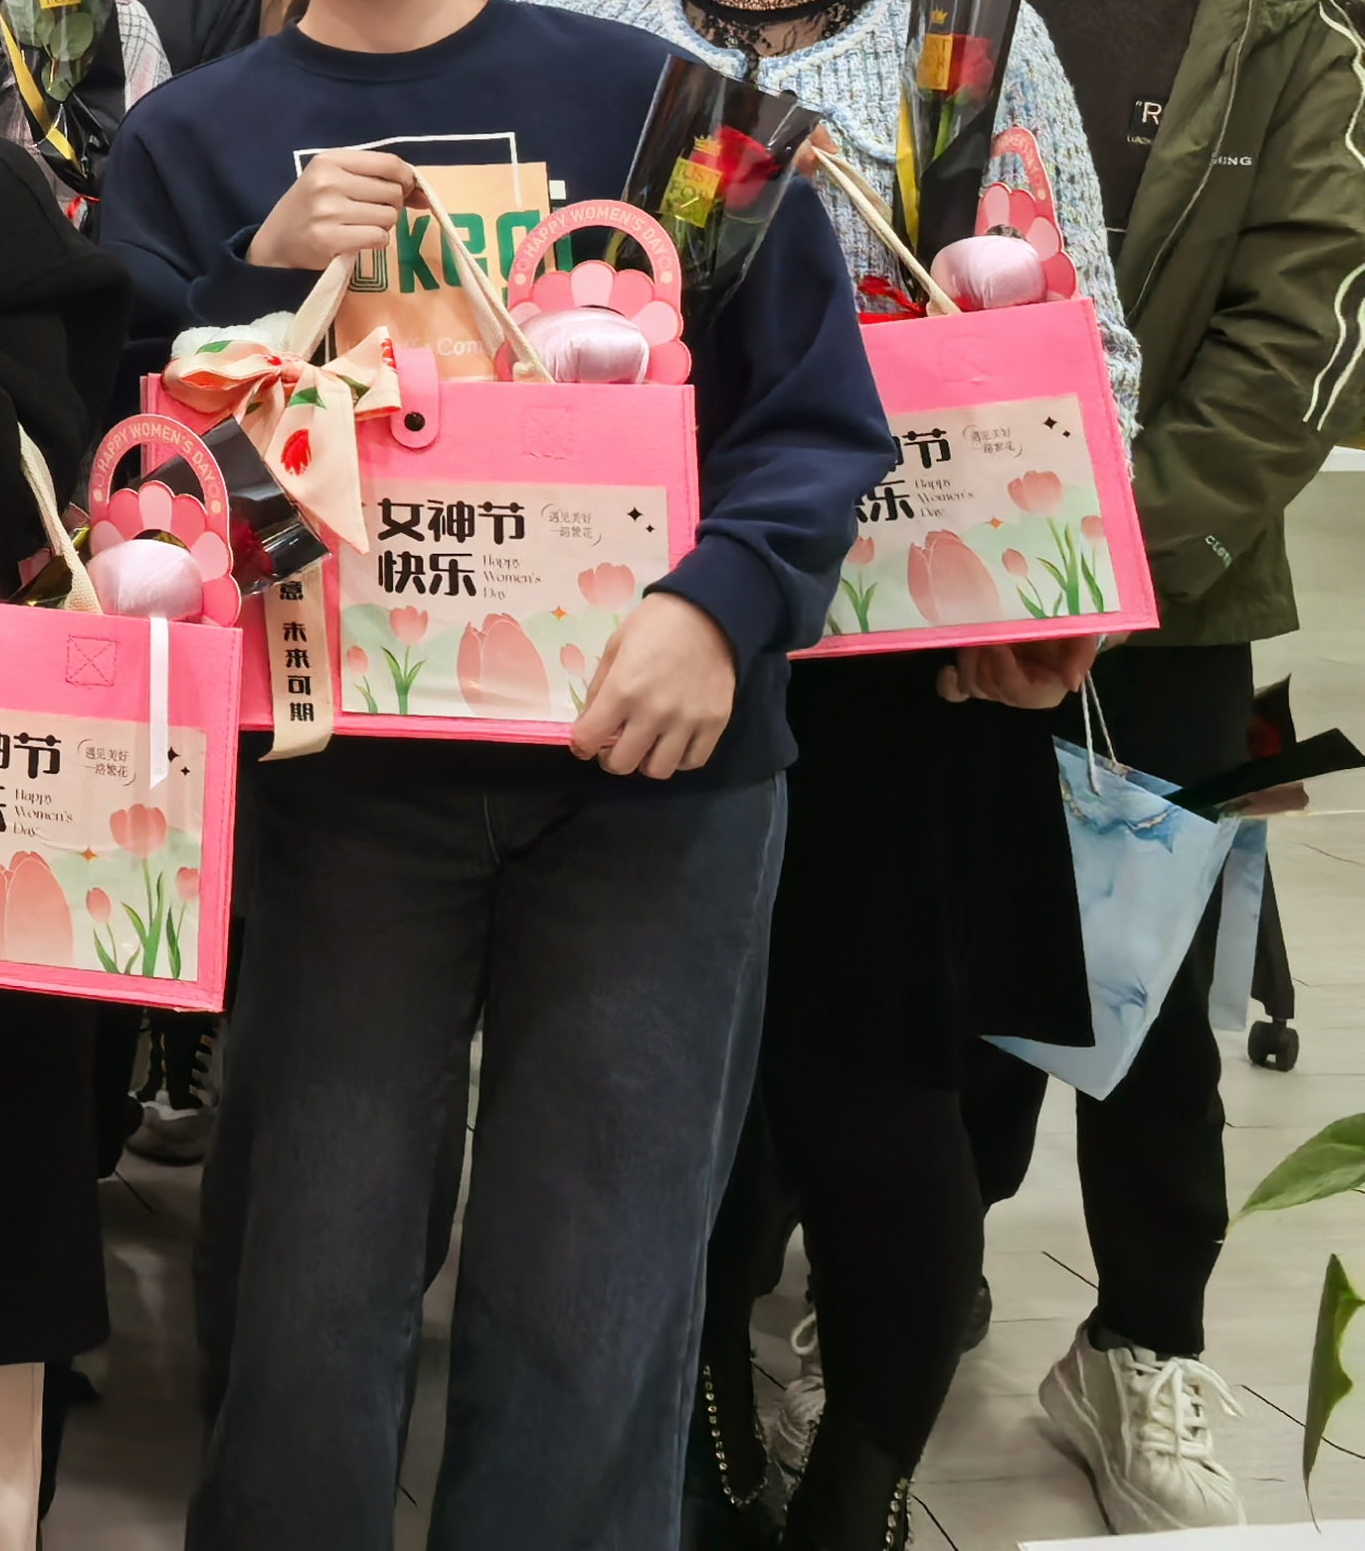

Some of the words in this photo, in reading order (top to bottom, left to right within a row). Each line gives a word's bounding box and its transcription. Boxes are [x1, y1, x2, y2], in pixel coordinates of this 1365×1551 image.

[526, 215, 567, 258] HAPPY
[642, 228, 666, 255] DAY
[97, 428, 129, 472] HAPPY
[192, 452, 215, 482] DAY
[377, 497, 526, 545] 女神节
[378, 550, 477, 597] 快乐
[482, 553, 521, 569] Happy
[282, 621, 315, 722] 未来可期
[14, 805, 74, 823] Women's
[15, 787, 53, 805] Happy
